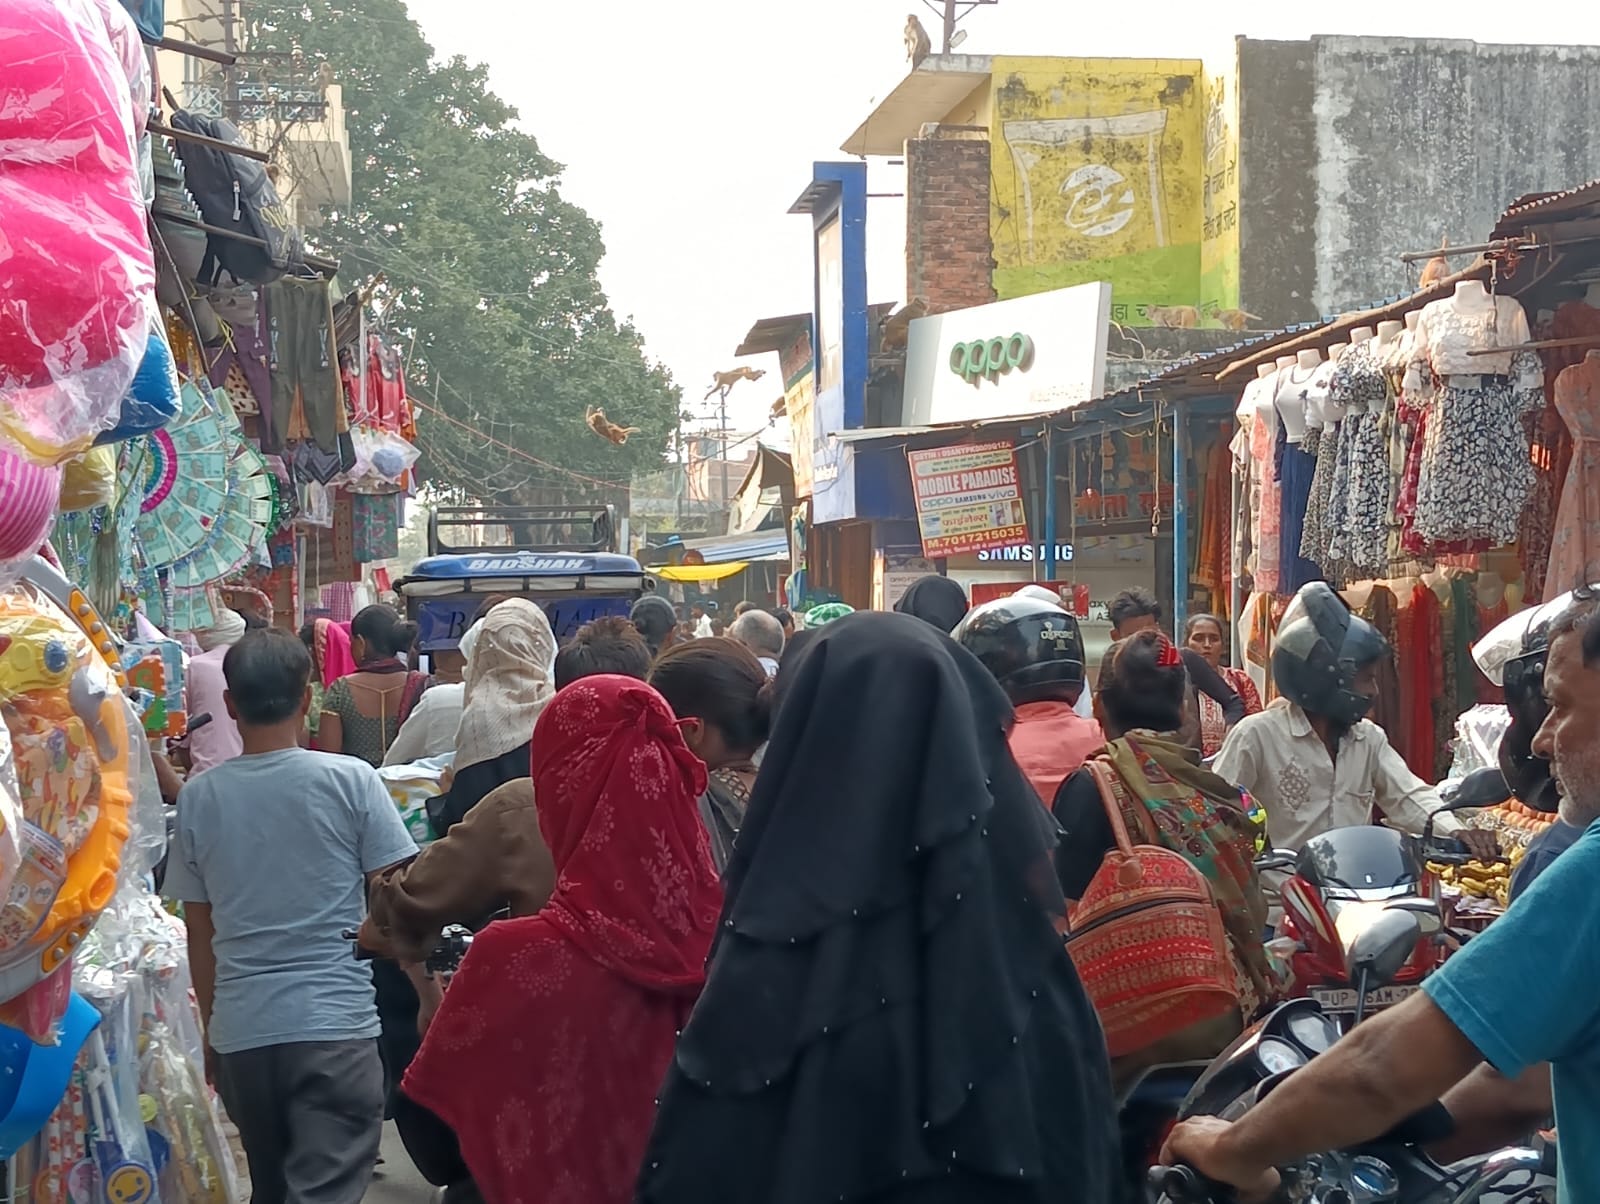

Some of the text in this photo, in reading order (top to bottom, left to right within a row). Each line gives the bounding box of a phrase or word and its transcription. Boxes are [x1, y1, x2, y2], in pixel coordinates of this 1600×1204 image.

[950, 332, 1030, 388] oppo
[917, 466, 1017, 497] MOBILE PARADISE
[988, 489, 1016, 500] vivo
[468, 556, 585, 570] BADSHAH
[1365, 988, 1393, 1003] 6AM
